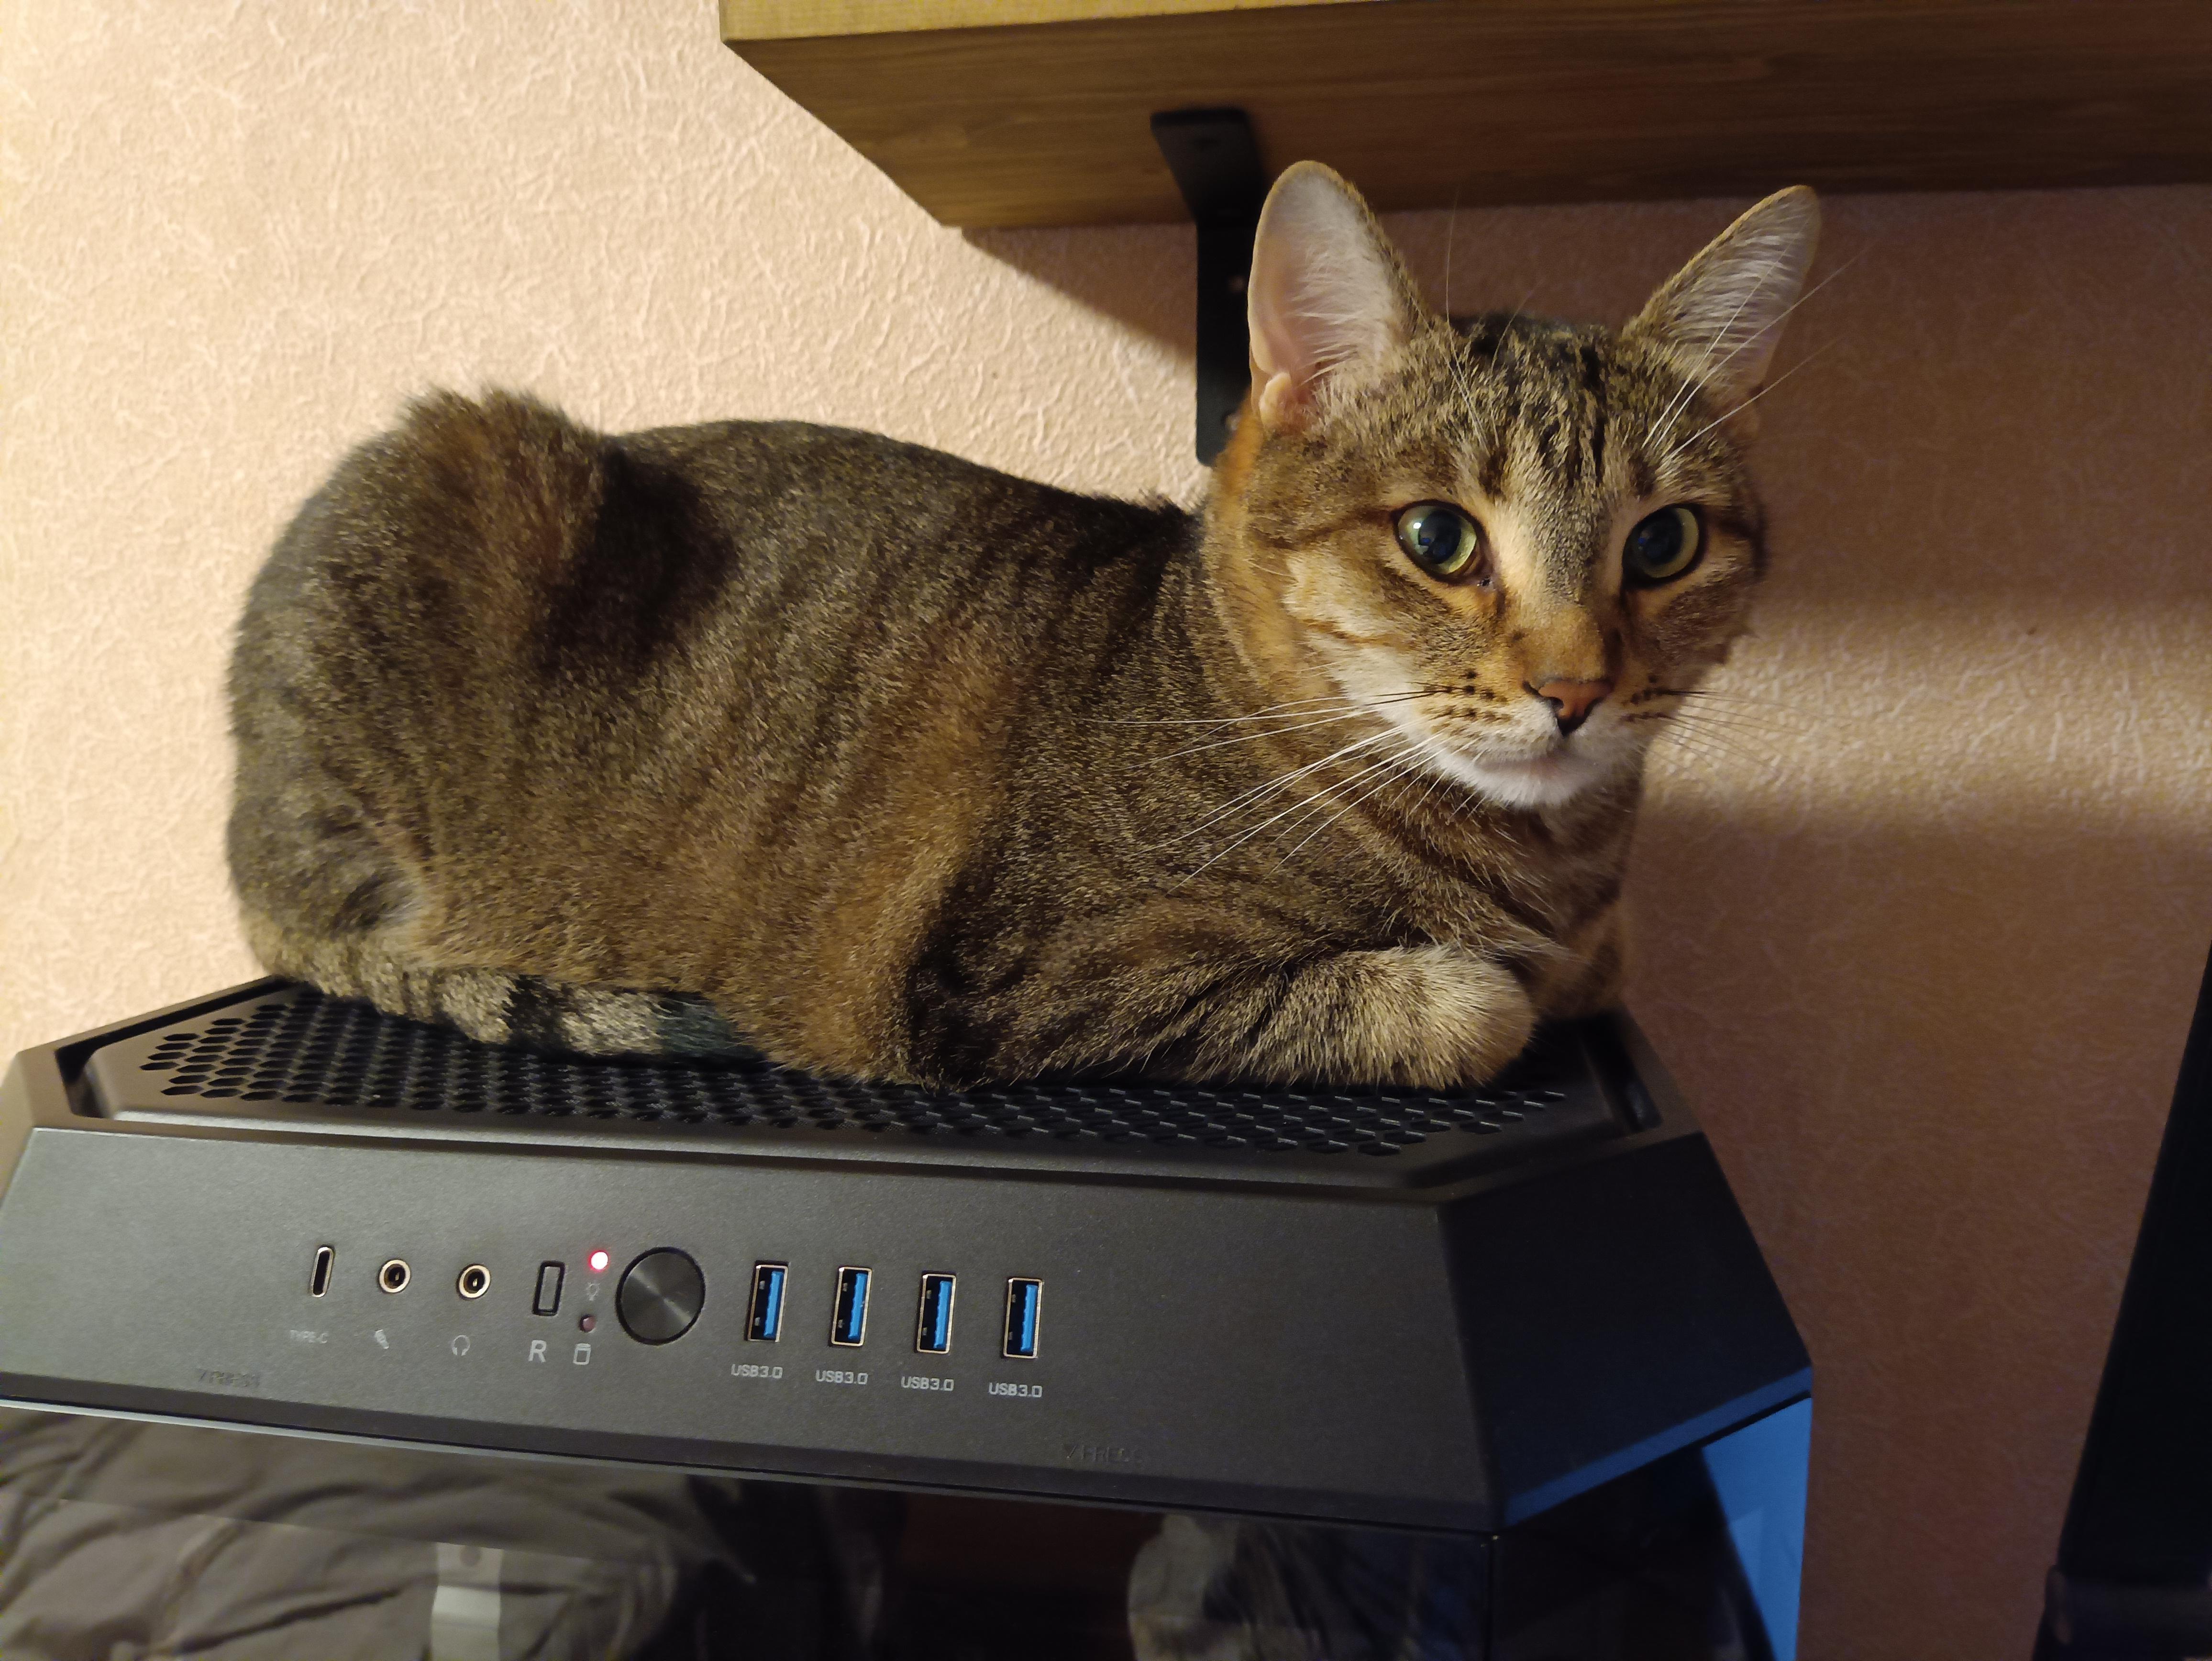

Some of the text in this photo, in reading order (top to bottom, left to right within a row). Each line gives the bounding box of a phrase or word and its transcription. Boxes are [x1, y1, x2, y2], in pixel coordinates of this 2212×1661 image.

[528, 1340, 547, 1362] R
[730, 1363, 783, 1379] USB3.0
[815, 1370, 869, 1385] USB3.0
[901, 1376, 954, 1392] USB3.0
[988, 1382, 1042, 1398] USB3.0
